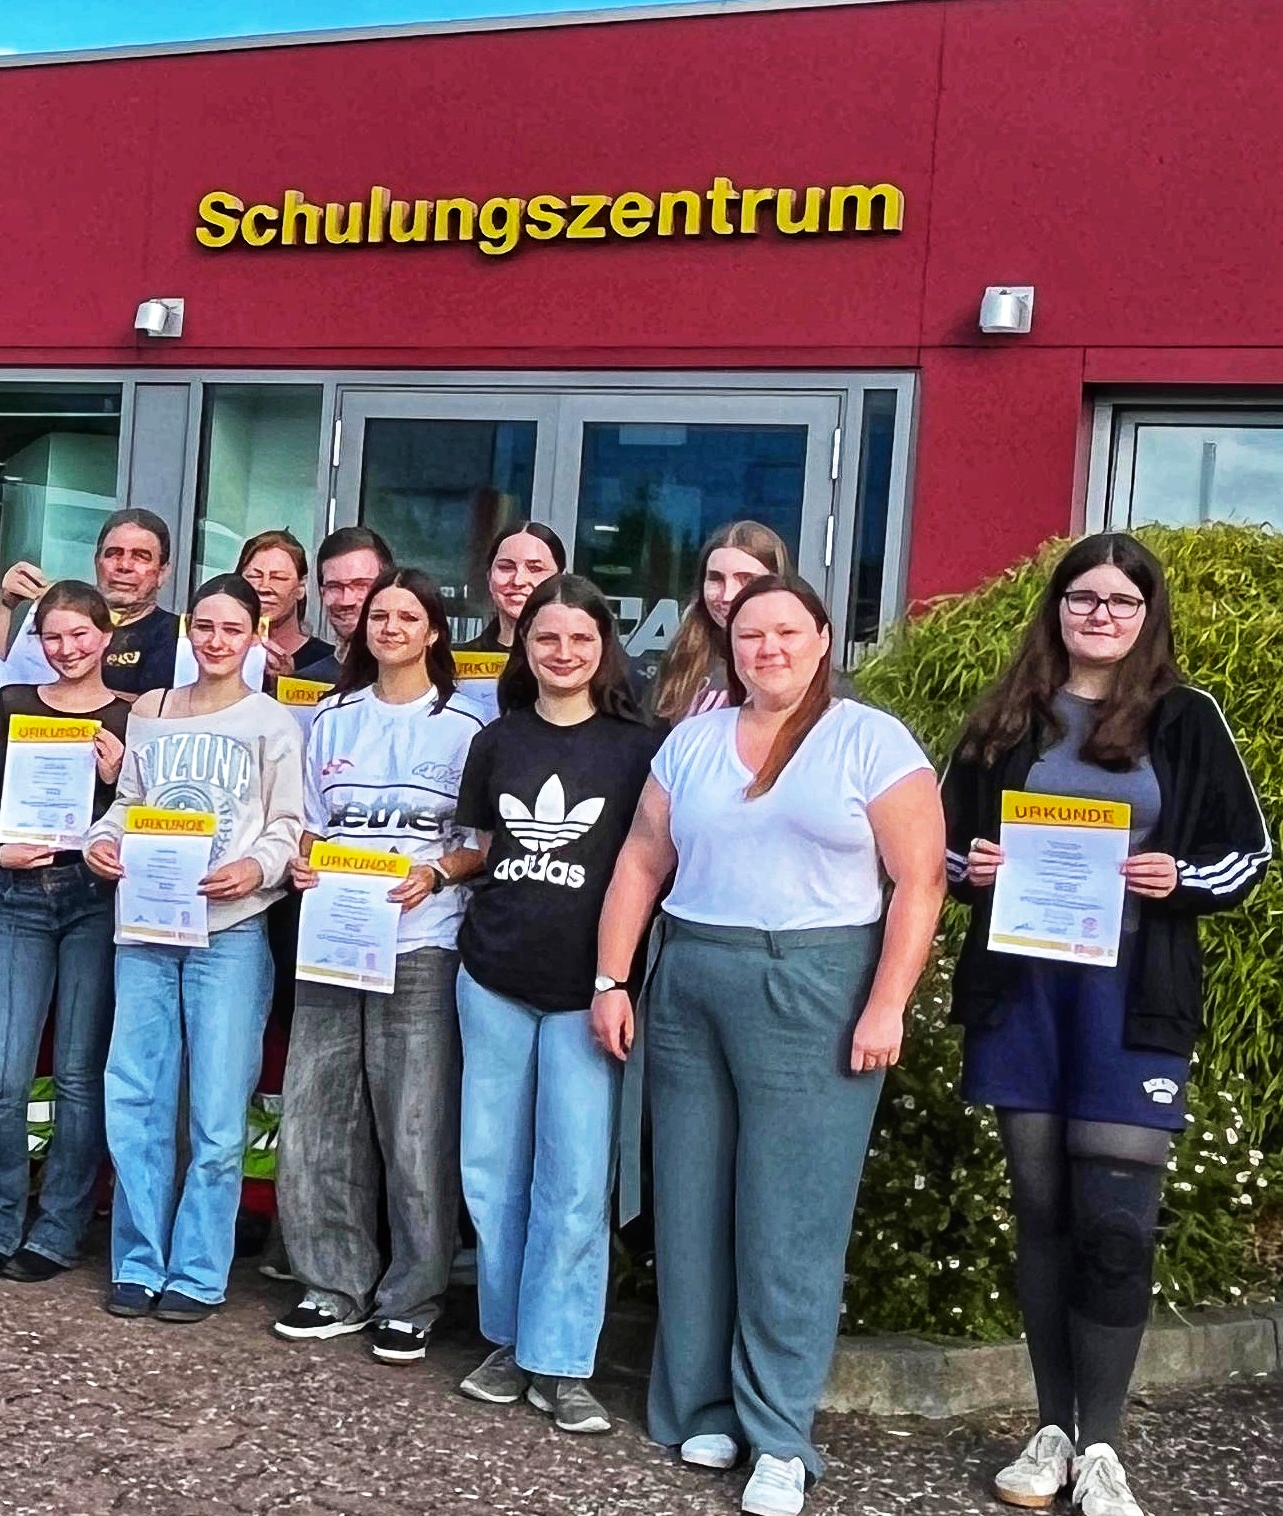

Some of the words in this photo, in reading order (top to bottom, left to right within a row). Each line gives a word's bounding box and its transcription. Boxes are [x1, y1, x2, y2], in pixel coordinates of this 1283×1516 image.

[195, 176, 905, 257] Schulungszentrum
[1014, 804, 1115, 824] URKUNDE
[493, 852, 586, 889] adidas
